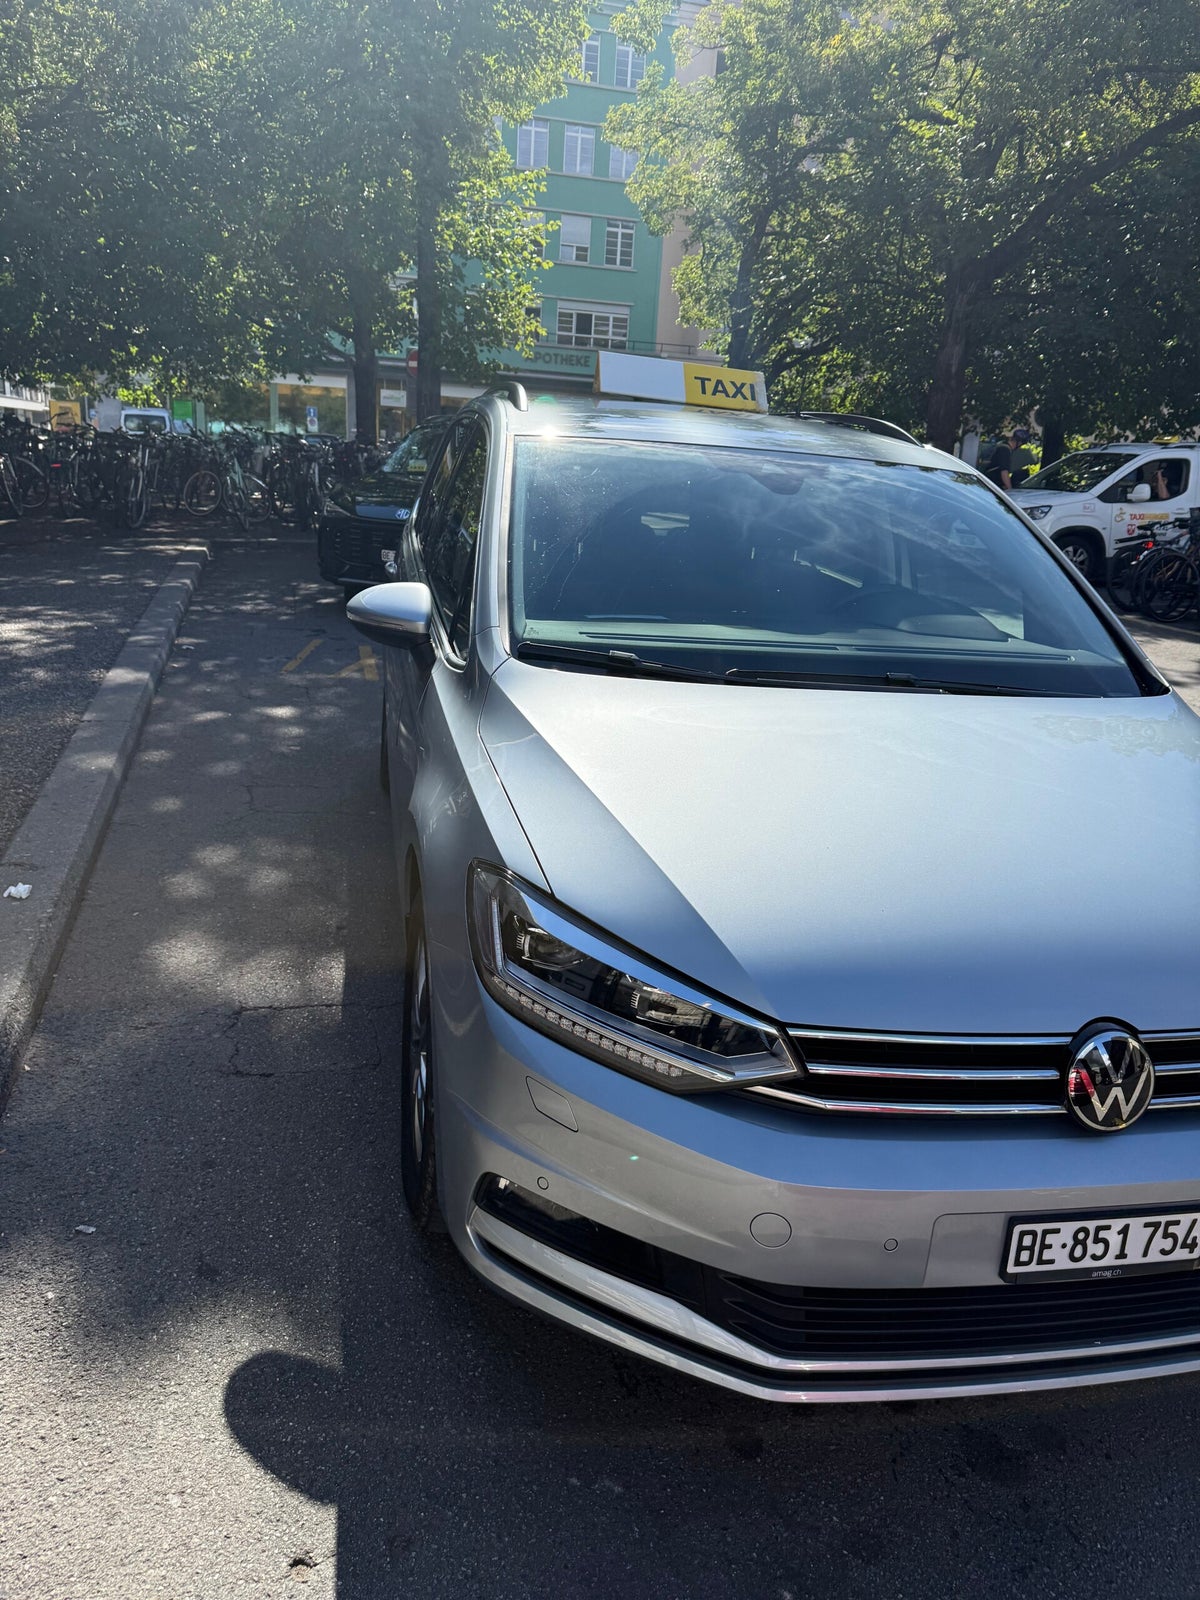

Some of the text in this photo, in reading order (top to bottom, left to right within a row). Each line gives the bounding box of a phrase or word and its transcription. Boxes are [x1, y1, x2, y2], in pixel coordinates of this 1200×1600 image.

[694, 376, 756, 401] TAXI
[1068, 1031, 1154, 1130] VW
[1141, 1218, 1198, 1258] 754
[1091, 1268, 1122, 1278] amag.ch
